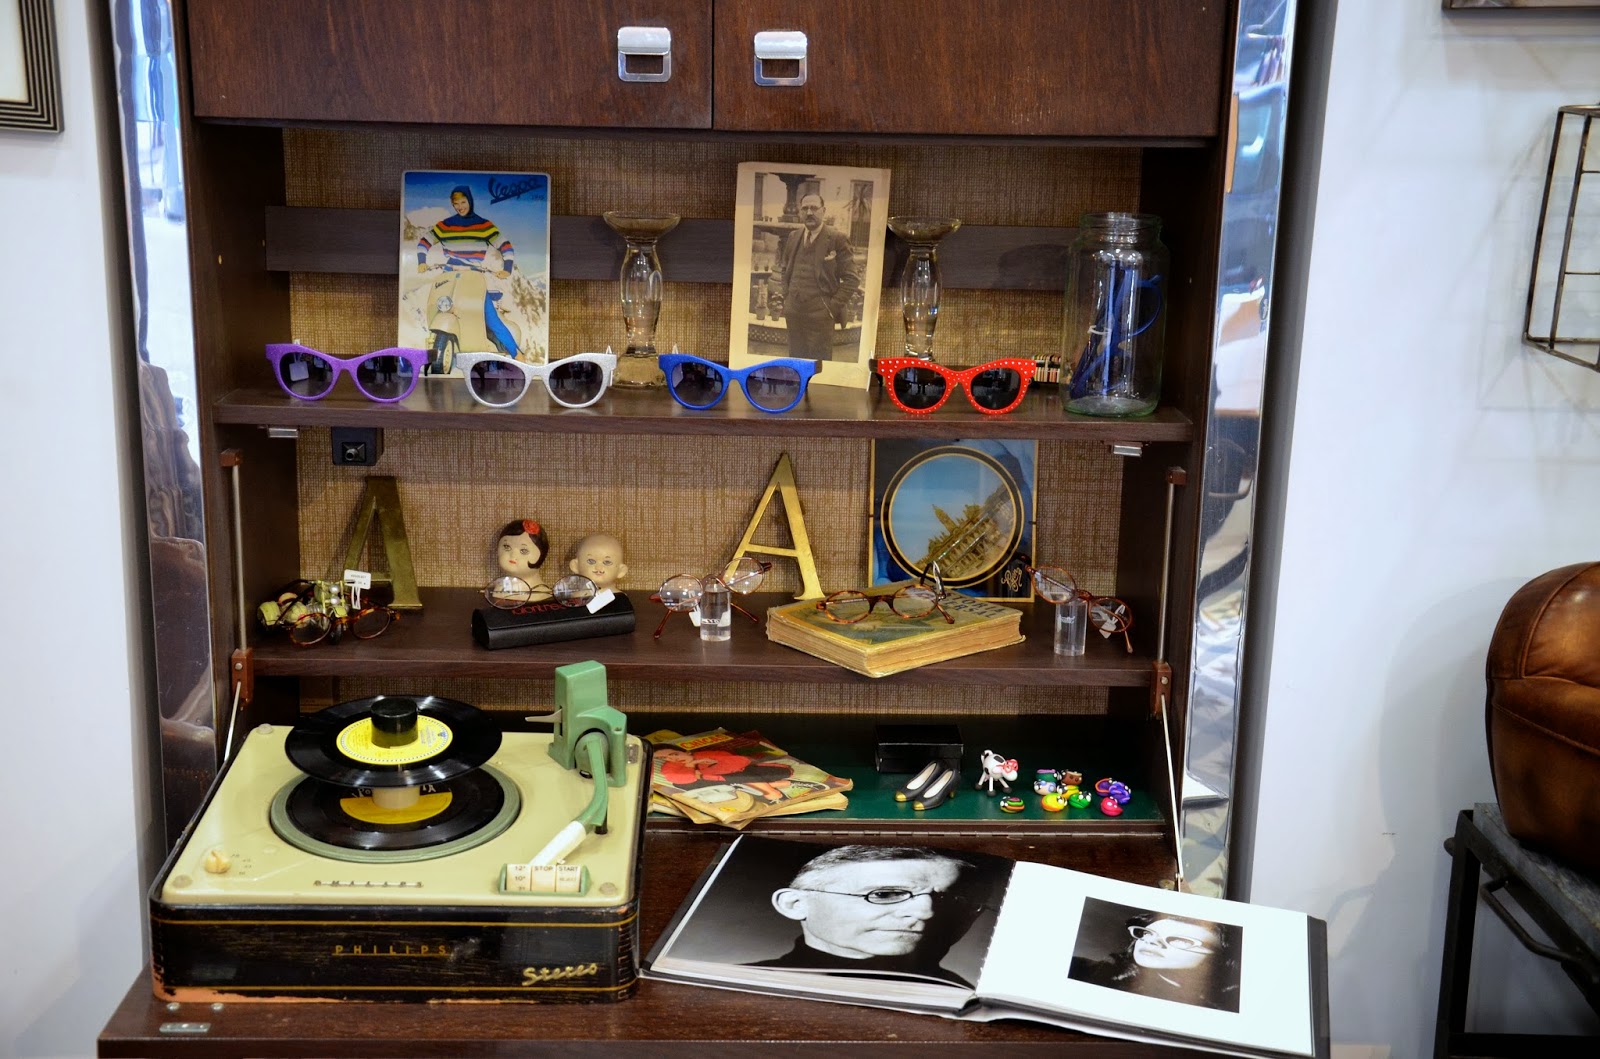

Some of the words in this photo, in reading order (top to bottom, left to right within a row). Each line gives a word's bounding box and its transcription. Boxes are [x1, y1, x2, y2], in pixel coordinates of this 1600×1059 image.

[488, 175, 544, 205] Vespa
[335, 944, 447, 956] PHILIPS
[521, 962, 598, 987] Stereo
